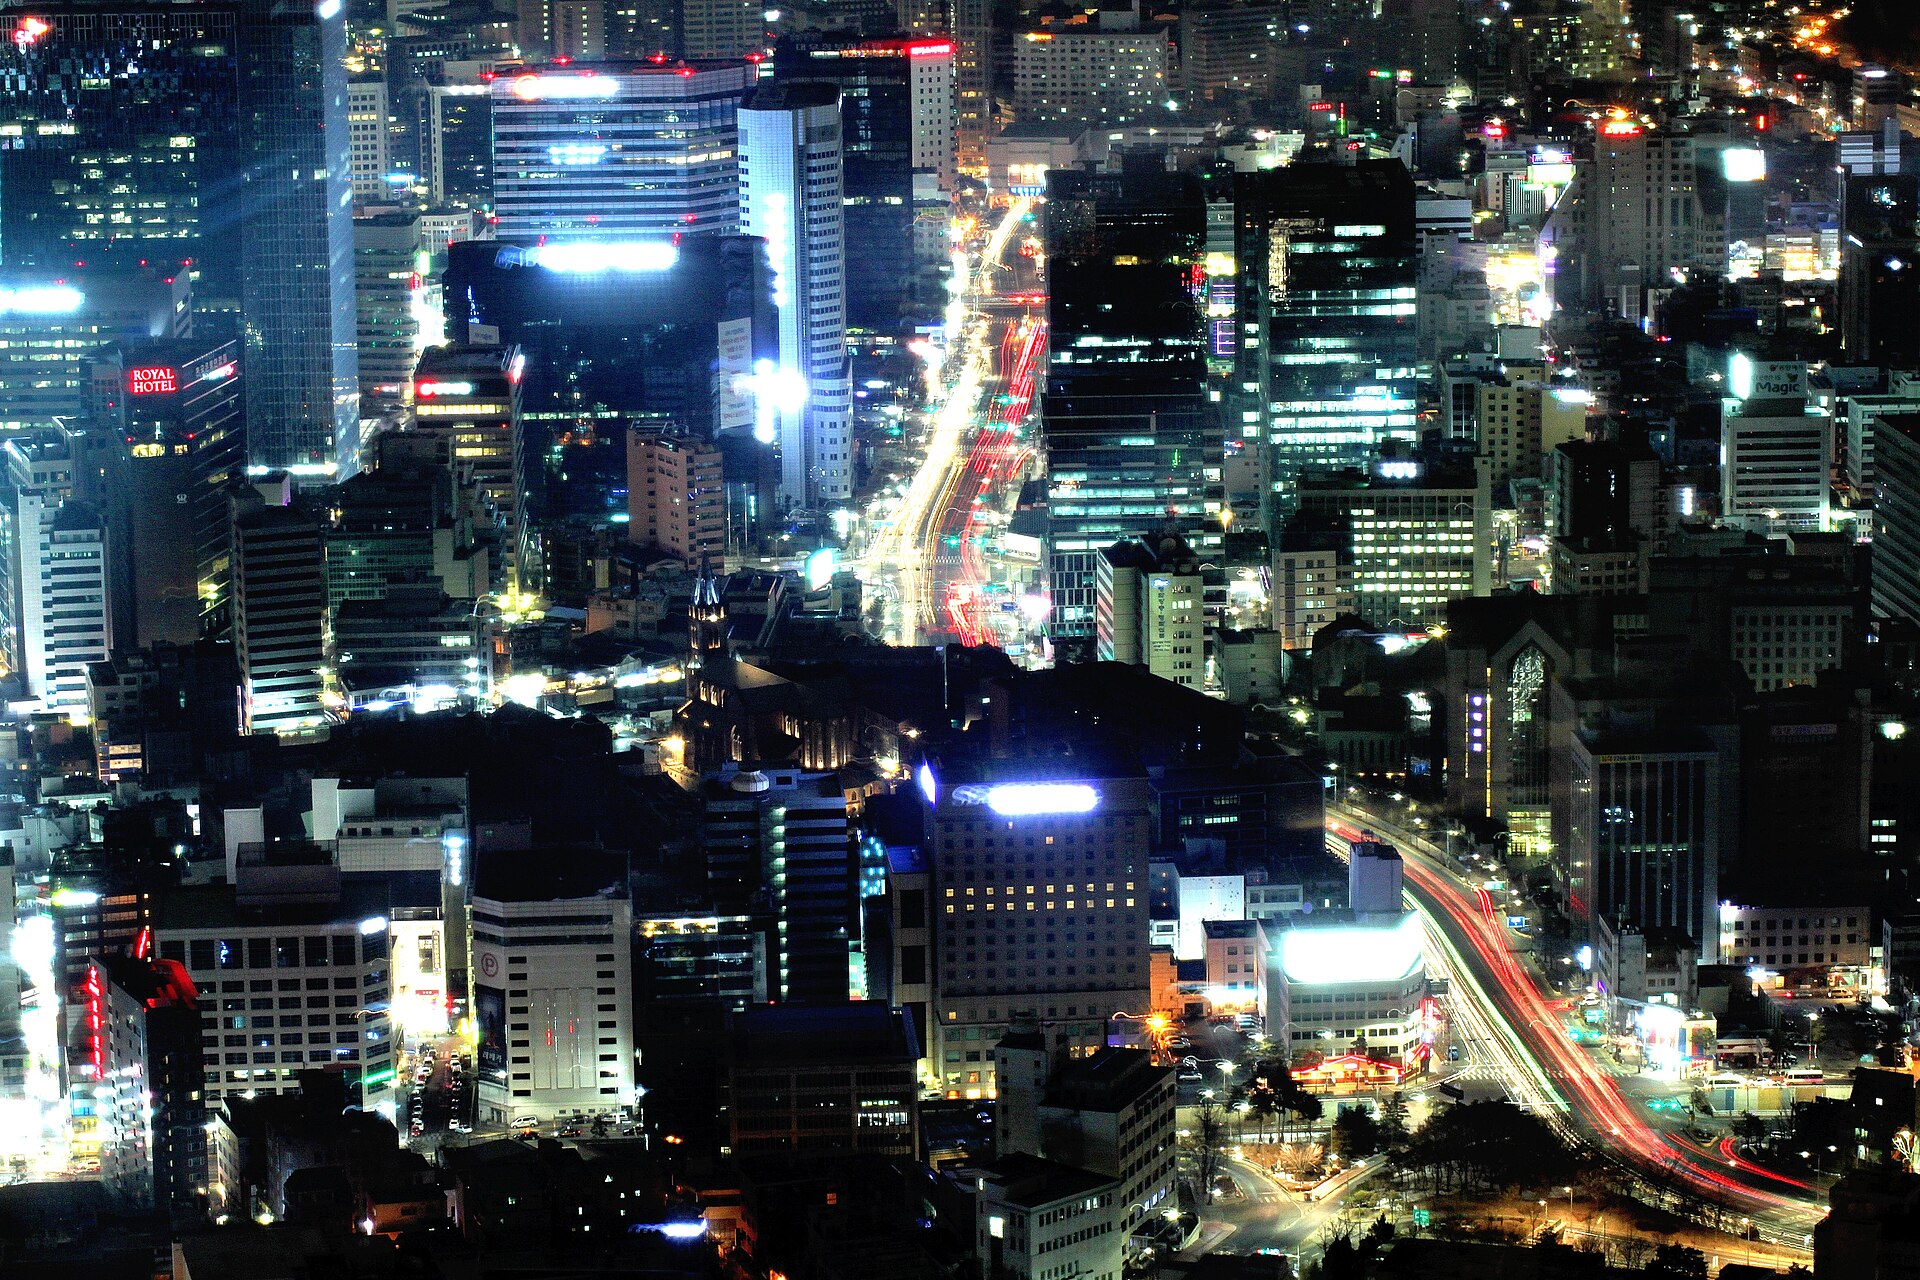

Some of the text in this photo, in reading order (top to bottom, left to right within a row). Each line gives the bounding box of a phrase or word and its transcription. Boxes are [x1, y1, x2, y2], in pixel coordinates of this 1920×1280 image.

[16, 30, 35, 43] SK
[133, 368, 175, 381] ROYAL
[133, 380, 176, 393] HOTEL
[1755, 381, 1801, 396] Magic
